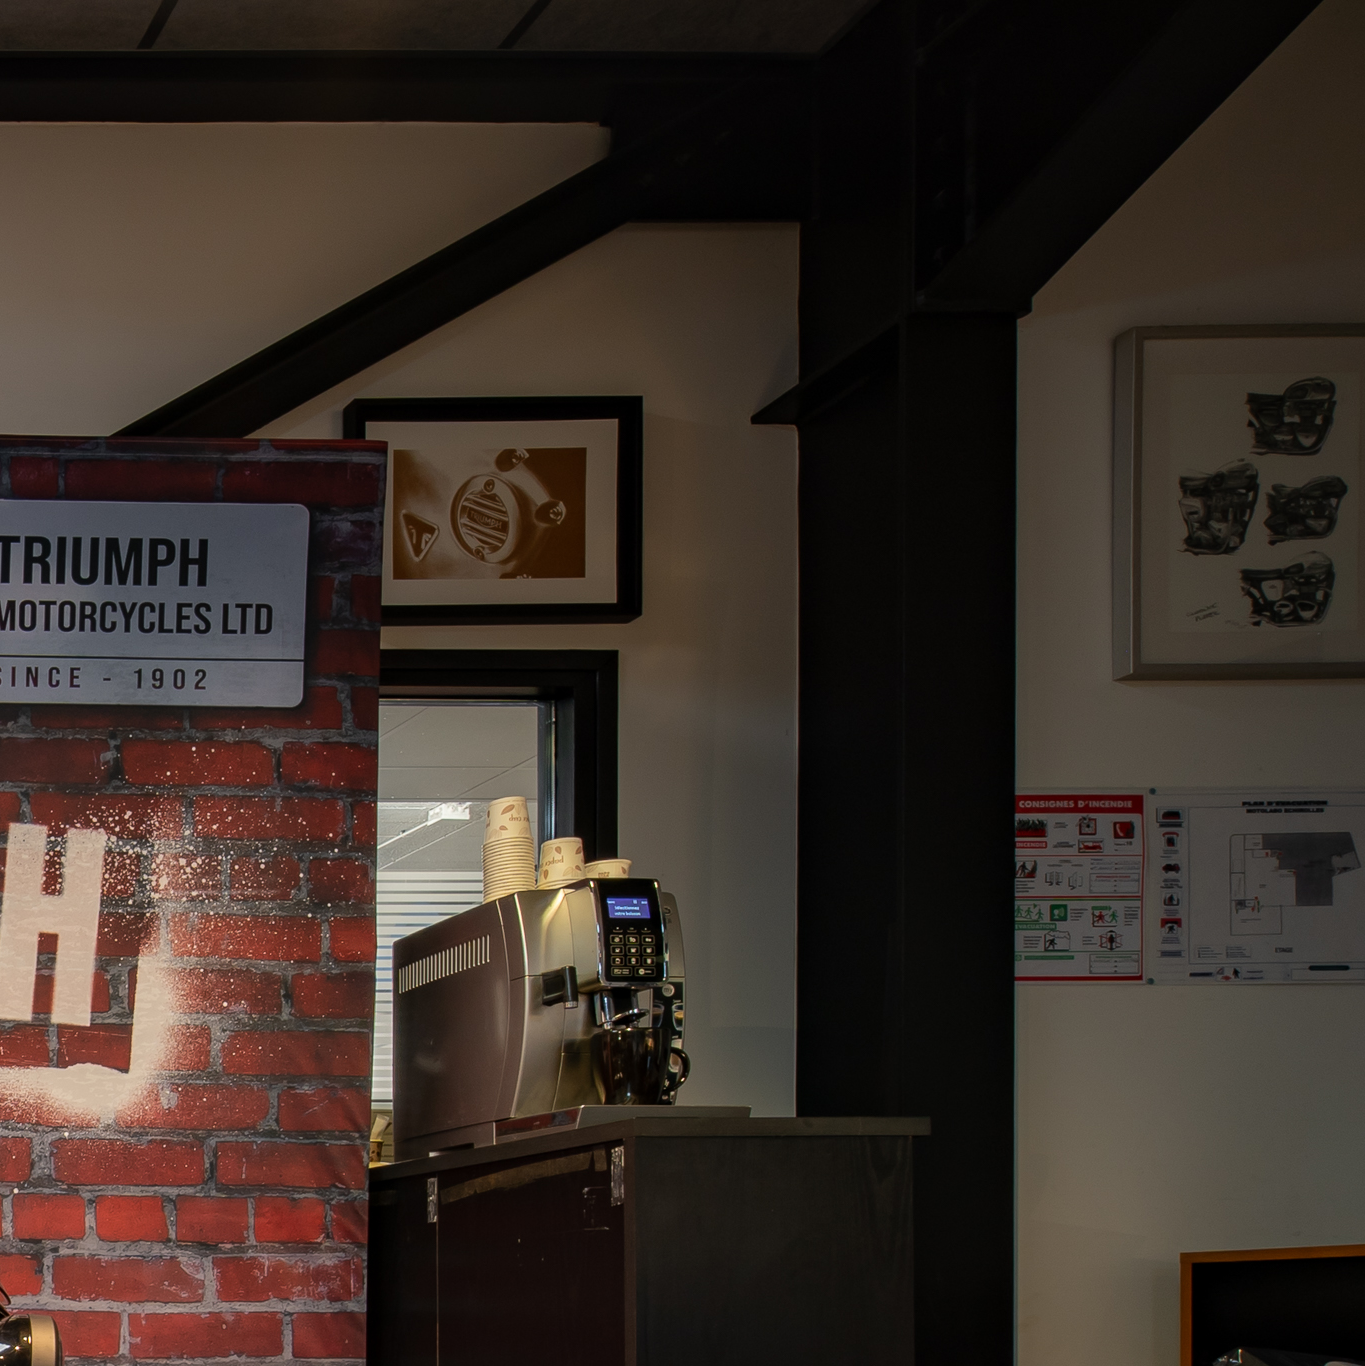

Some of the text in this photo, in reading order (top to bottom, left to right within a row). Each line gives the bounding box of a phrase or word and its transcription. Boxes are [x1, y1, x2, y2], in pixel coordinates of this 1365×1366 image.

[470, 511, 502, 529] TRIUMPH
[221, 603, 273, 635] LTD
[133, 668, 208, 691] 1902
[1019, 800, 1133, 808] CONSIGNES D'INCENDIE
